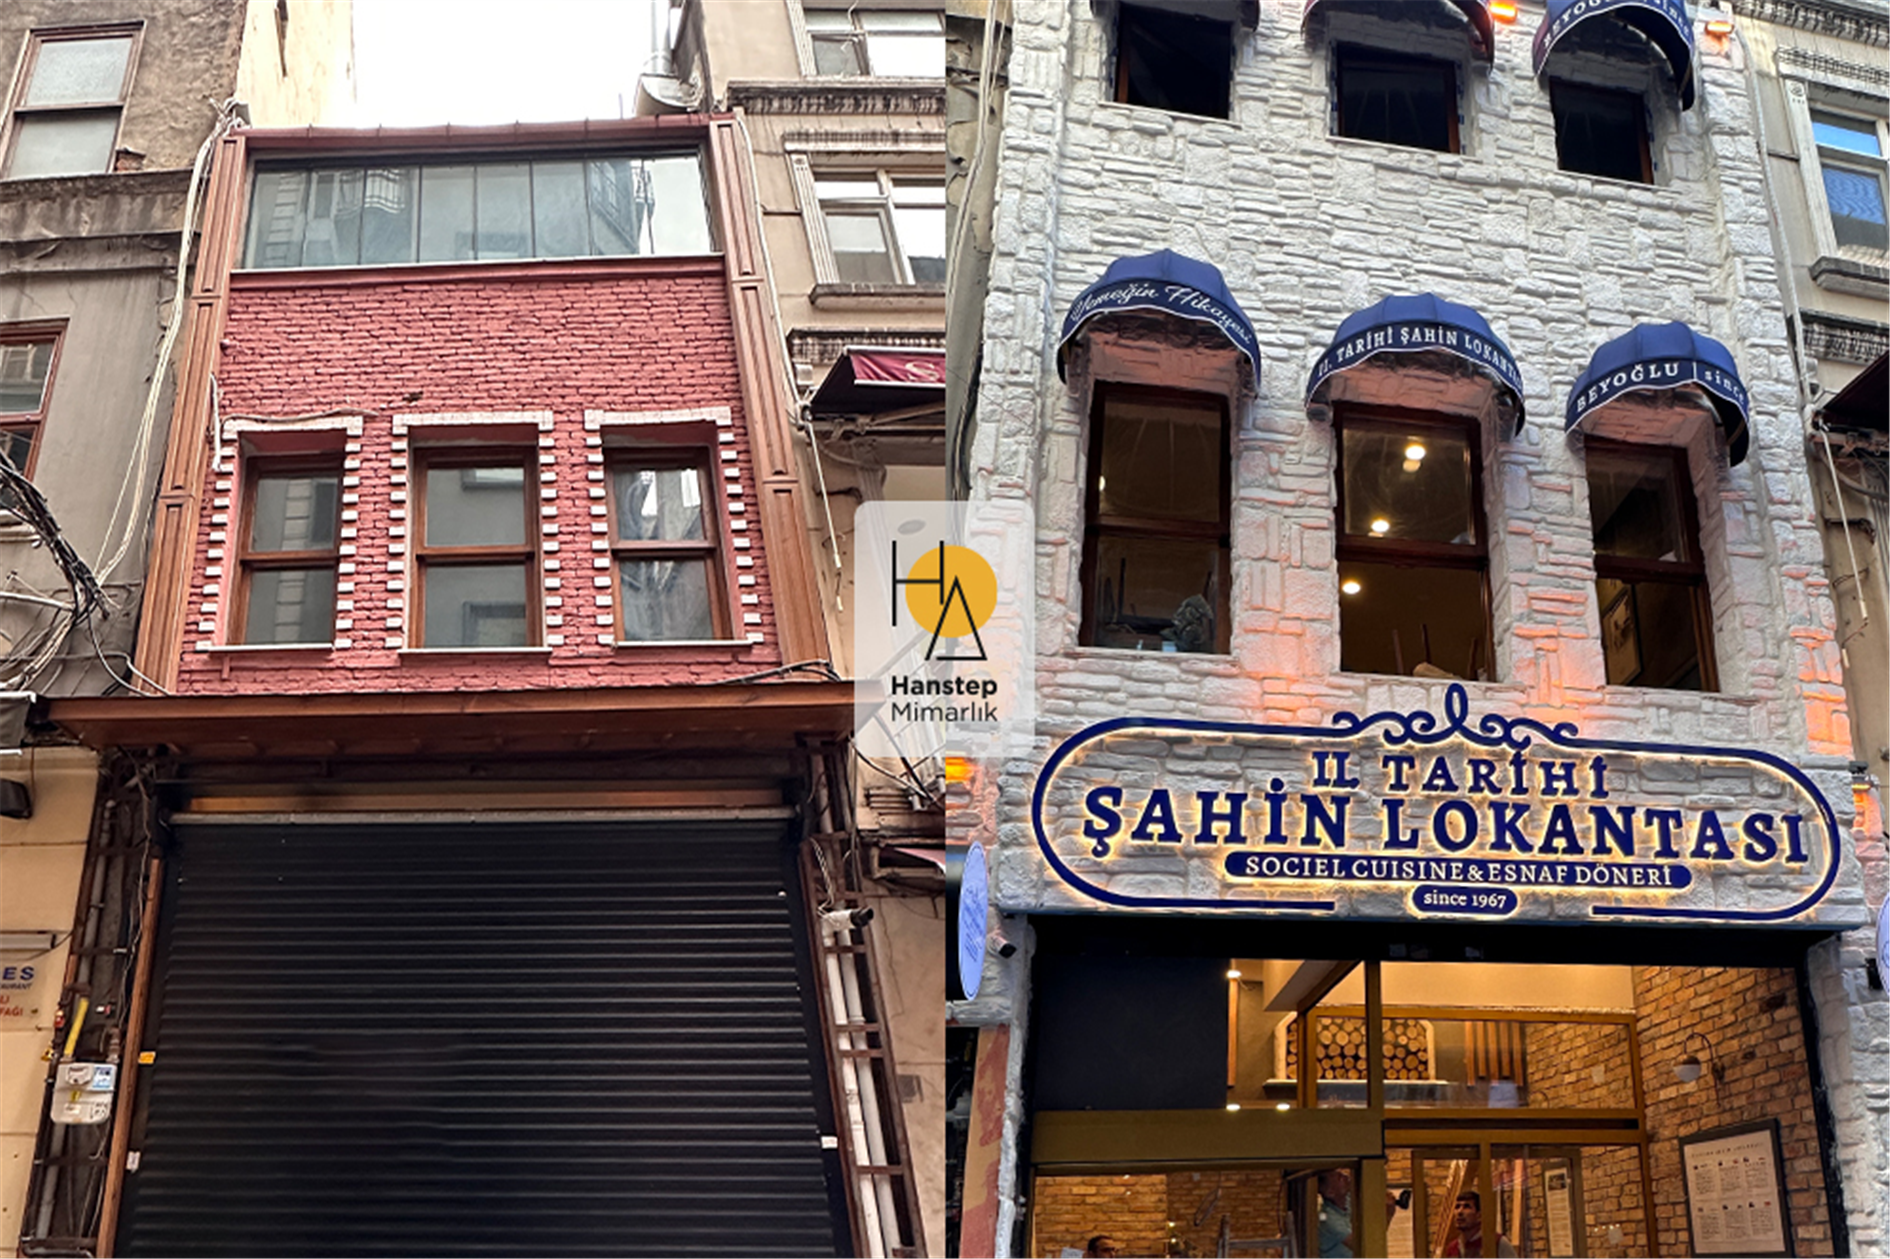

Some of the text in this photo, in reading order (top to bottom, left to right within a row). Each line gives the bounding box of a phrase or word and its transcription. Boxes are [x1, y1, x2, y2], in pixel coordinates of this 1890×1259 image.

[1336, 325, 1394, 363] TARİHİ
[1400, 325, 1458, 345] ŞAHİN
[1576, 361, 1745, 413] BEYOĞLU since
[1381, 749, 1610, 800] TARİHİ
[1082, 777, 1809, 864] ŞAHİN LOKANTASI
[1245, 855, 1346, 878] SOCIEL
[1575, 862, 1673, 887] DÖNERİ
[1423, 888, 1508, 909] since 1967
